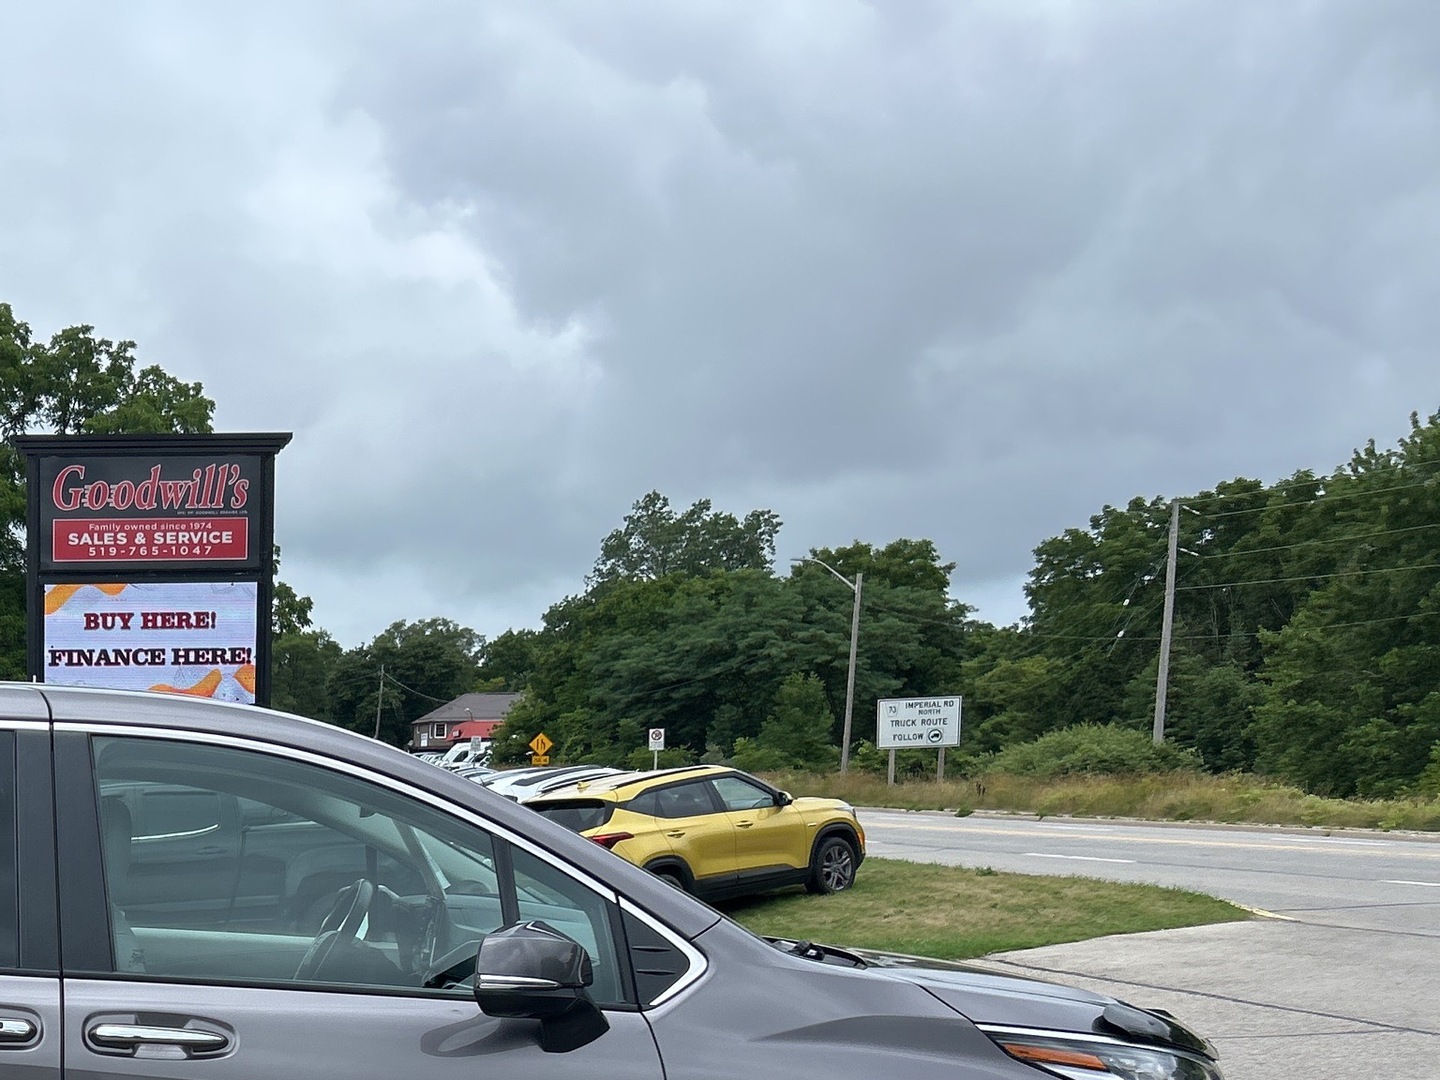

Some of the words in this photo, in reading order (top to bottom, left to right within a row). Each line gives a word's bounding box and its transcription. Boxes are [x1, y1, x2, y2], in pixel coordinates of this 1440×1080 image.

[52, 463, 249, 511] Goodwill's
[89, 523, 121, 532] Family
[124, 523, 157, 531] owned
[189, 522, 213, 530] 1974
[68, 532, 128, 546] SALES
[134, 532, 147, 545] &
[154, 531, 233, 545] SERVICE
[89, 546, 213, 557] 519-765-1047
[83, 612, 134, 630] BUY
[140, 611, 217, 629] HERE!
[48, 648, 166, 667] FINANCE
[171, 647, 253, 665] HERE!
[905, 701, 941, 709] IMPERIAL
[943, 700, 954, 708] RD
[890, 719, 917, 727] TRUCK
[921, 717, 948, 726] ROUTE
[892, 733, 924, 741] FOLLOW
